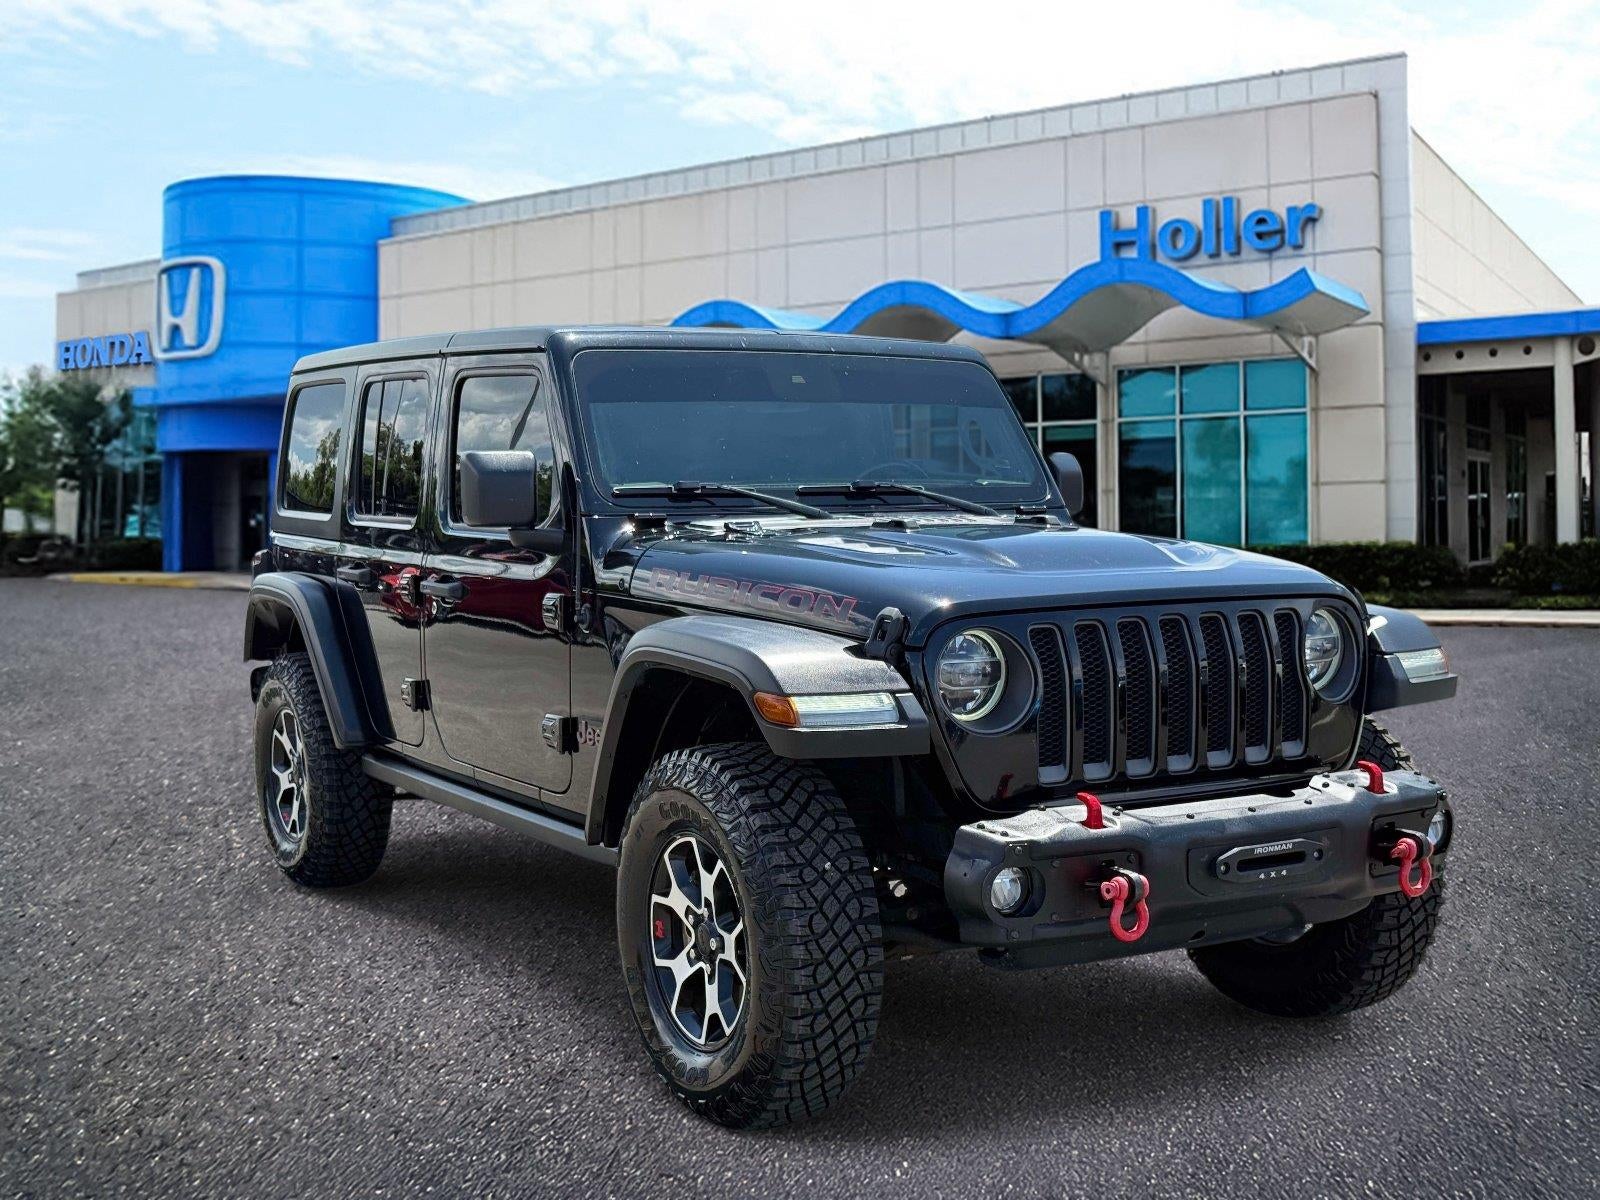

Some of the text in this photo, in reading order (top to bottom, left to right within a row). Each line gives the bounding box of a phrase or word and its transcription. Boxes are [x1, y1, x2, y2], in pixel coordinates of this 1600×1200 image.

[1099, 196, 1322, 260] Holler
[57, 331, 153, 370] HONDA
[650, 567, 857, 623] RUBICON
[576, 720, 601, 746] Jee
[1254, 842, 1293, 854] IRONMAN
